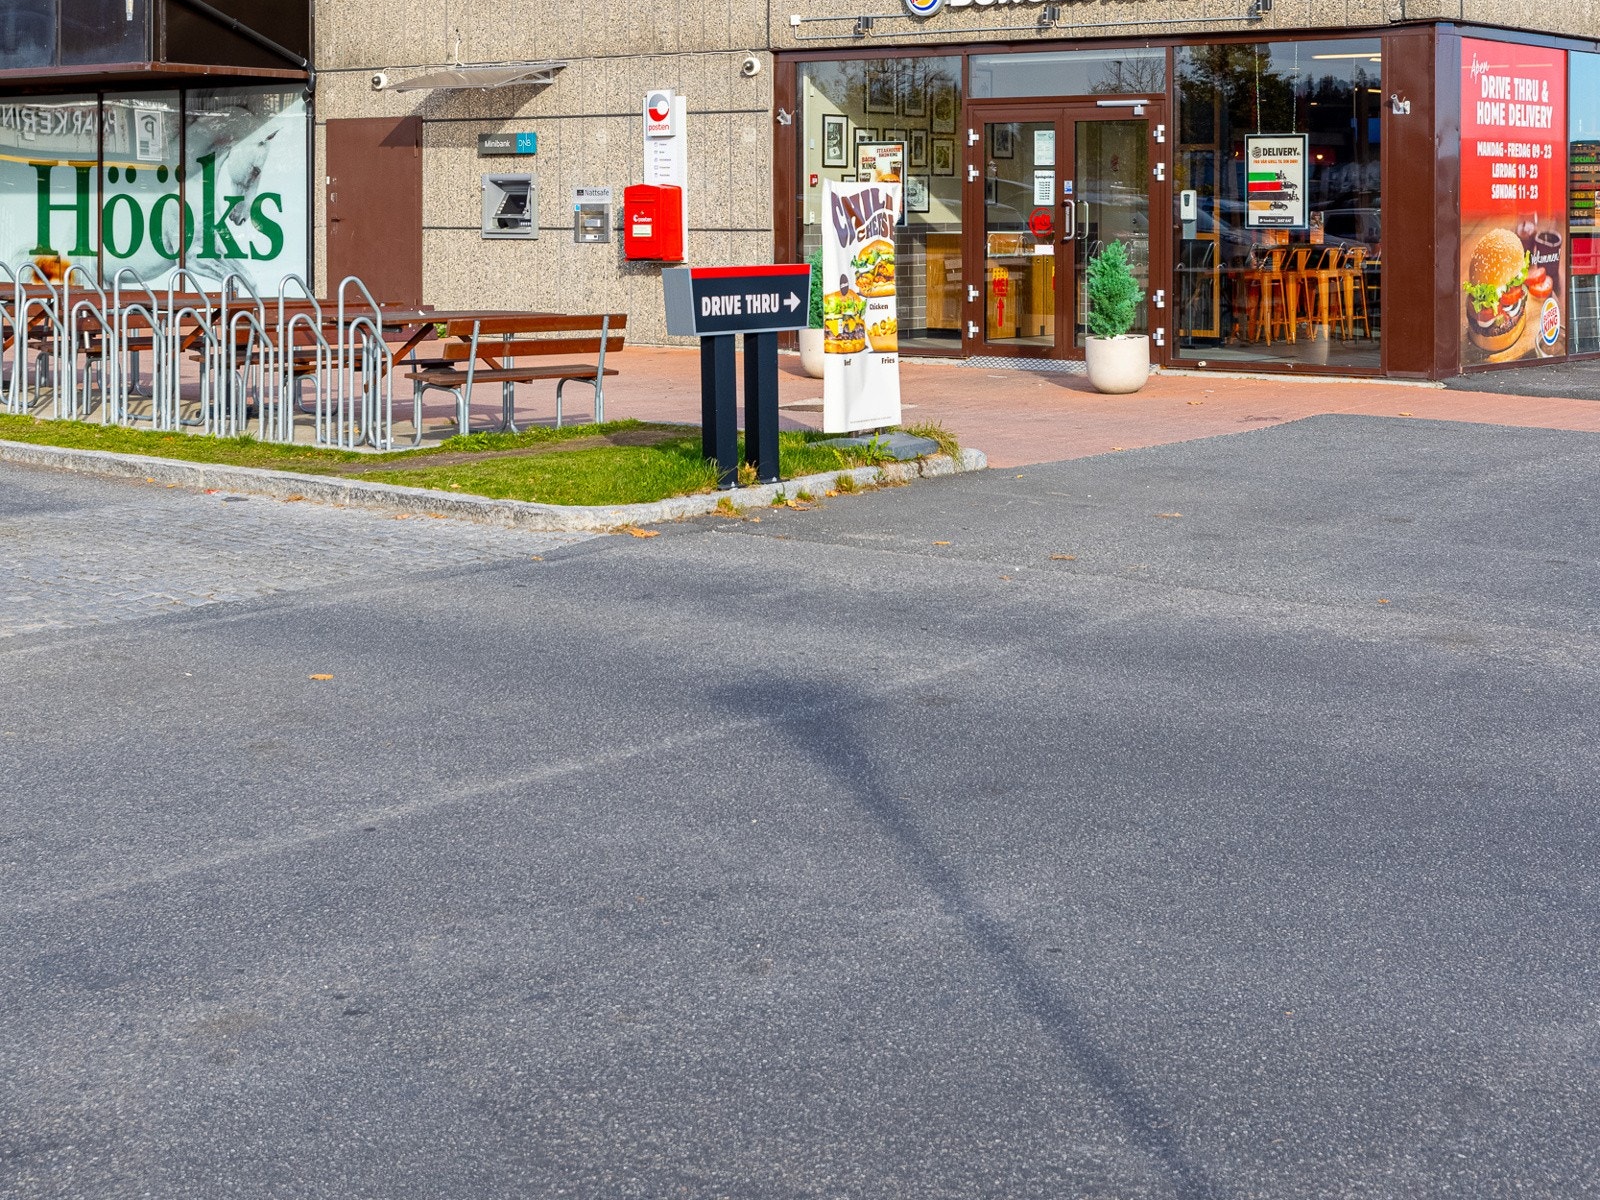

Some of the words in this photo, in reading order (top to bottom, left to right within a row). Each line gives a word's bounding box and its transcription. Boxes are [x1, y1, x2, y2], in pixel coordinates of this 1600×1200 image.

[1481, 75, 1511, 100] DRIVE
[1514, 77, 1539, 102] THRU
[1541, 80, 1549, 103] &
[1477, 101, 1506, 126] HOME
[1509, 103, 1553, 129] DELIVERY
[648, 124, 670, 132] posten
[484, 139, 511, 148] Minibank
[1477, 141, 1504, 158] MANDAG
[1507, 142, 1531, 159] FREDAG
[1544, 144, 1552, 159] 23
[1262, 147, 1298, 157] DELIVERY
[1491, 163, 1516, 179] LØRDAG
[1518, 164, 1527, 179] 10
[1530, 164, 1538, 179] 23
[585, 188, 610, 197] Nattsafe
[1491, 184, 1516, 200] SØNDAG
[1518, 184, 1527, 199] 11
[1530, 185, 1538, 200] 23
[28, 153, 285, 263] Hööks
[701, 295, 742, 317] DRIVE
[745, 292, 780, 314] THRU
[881, 357, 896, 365] Fries
